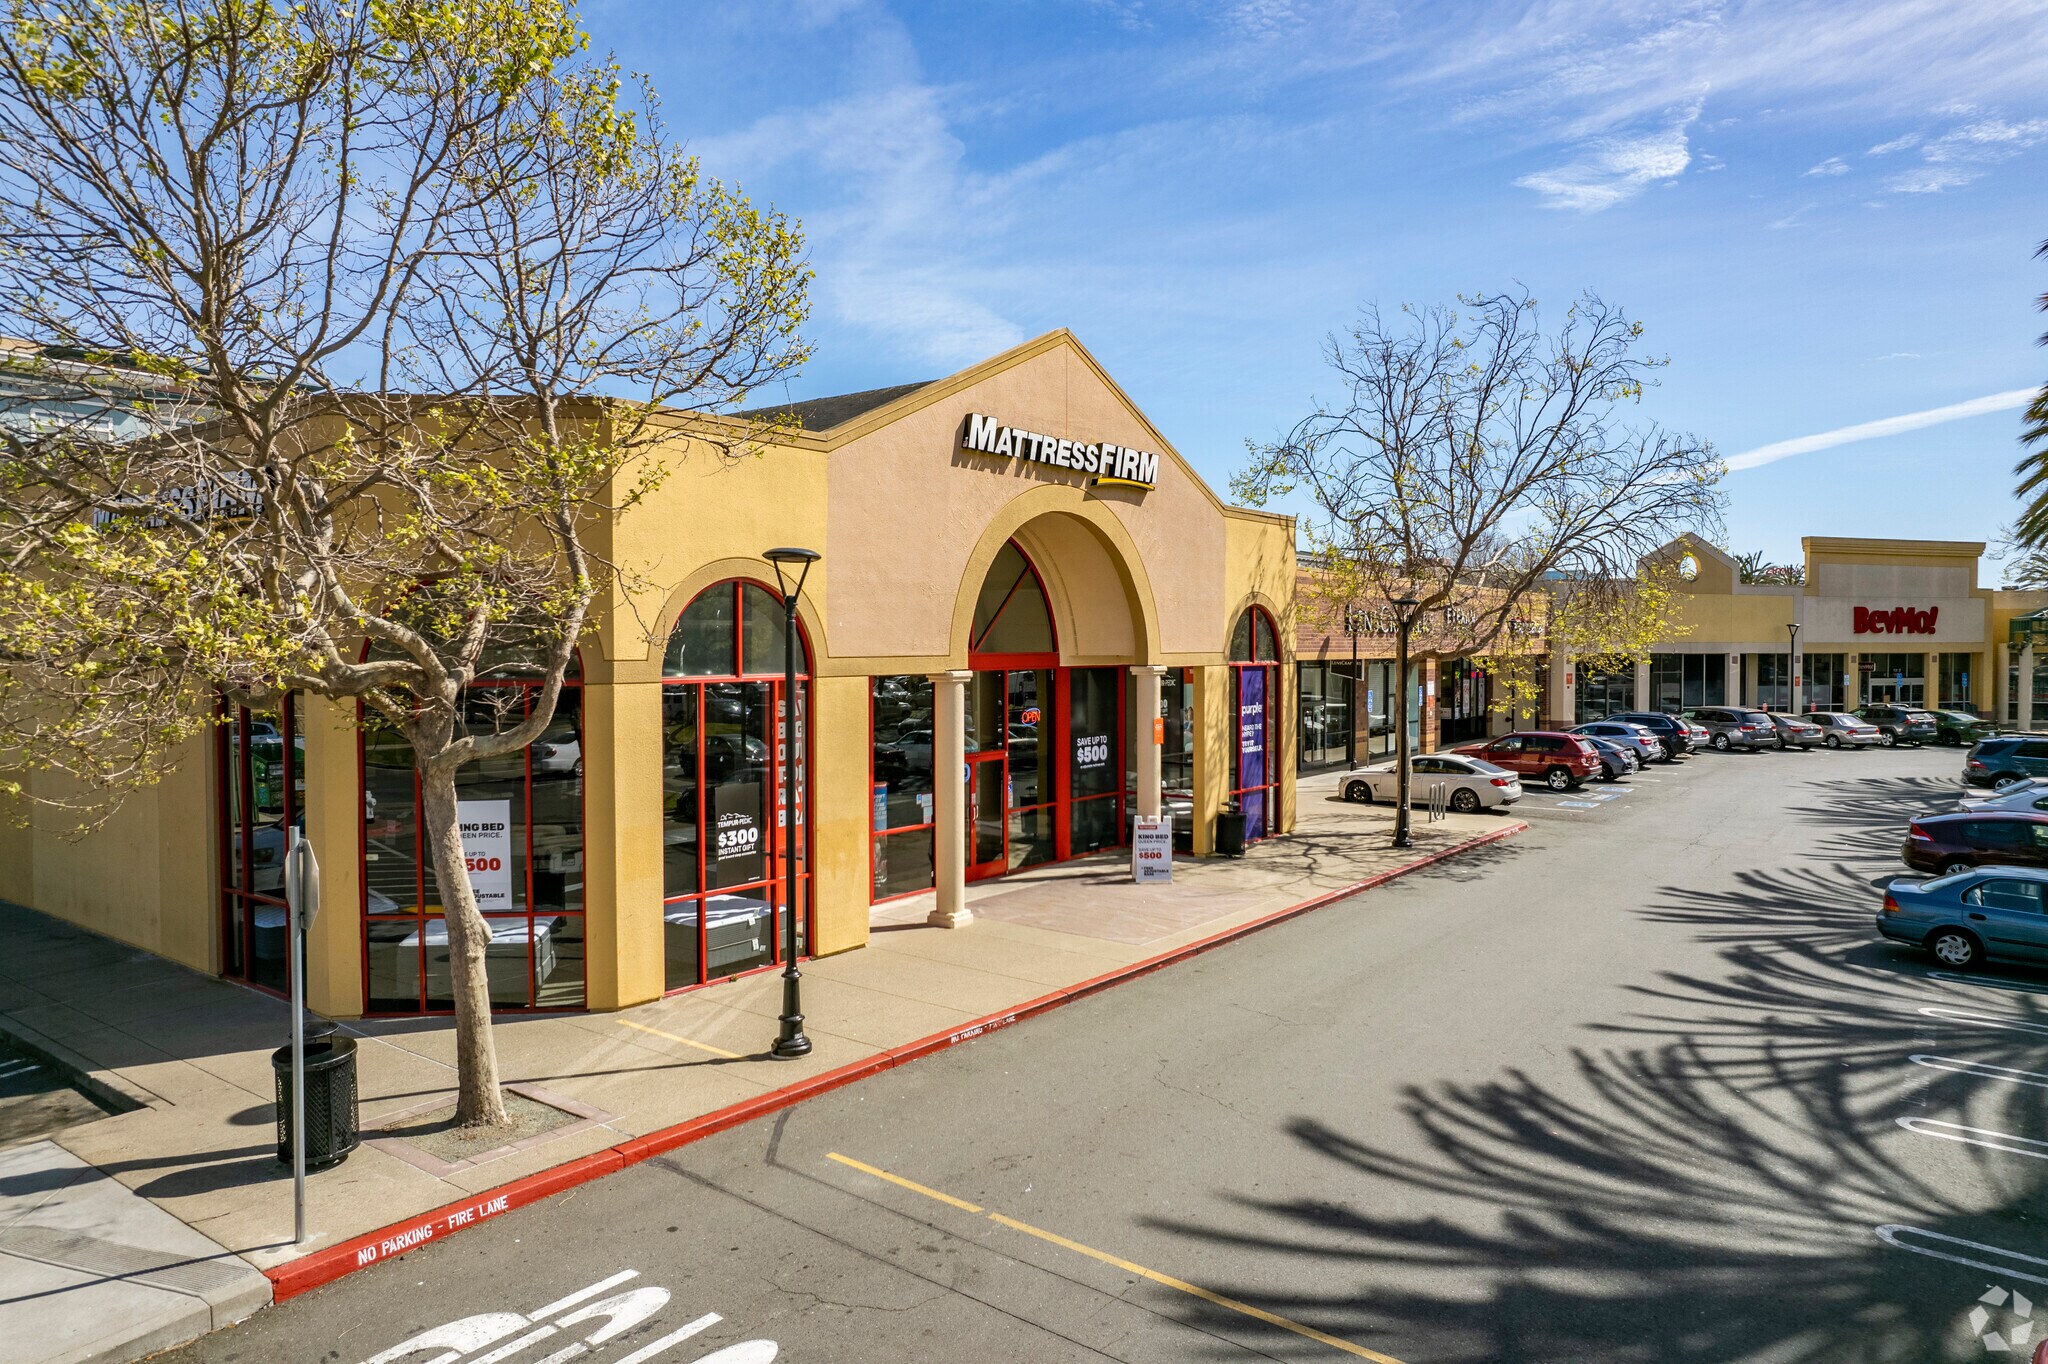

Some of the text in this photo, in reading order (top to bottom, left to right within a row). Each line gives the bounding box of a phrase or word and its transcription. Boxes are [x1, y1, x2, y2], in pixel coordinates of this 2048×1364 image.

[1853, 606, 1939, 635] BevMo!
[1022, 711, 1040, 722] OPEN
[1241, 701, 1262, 717] purple
[1077, 735, 1107, 746] SAVE UP TO
[1077, 744, 1107, 764] $500
[460, 823, 504, 832] ING BED
[718, 827, 758, 848] $300
[718, 846, 742, 856] INSTANT
[742, 843, 755, 852] GIFT
[465, 857, 501, 872] 500
[357, 1246, 377, 1266] NO
[381, 1224, 433, 1256] PARKING
[448, 1208, 476, 1229] FIRE
[479, 1195, 509, 1217] LANE
